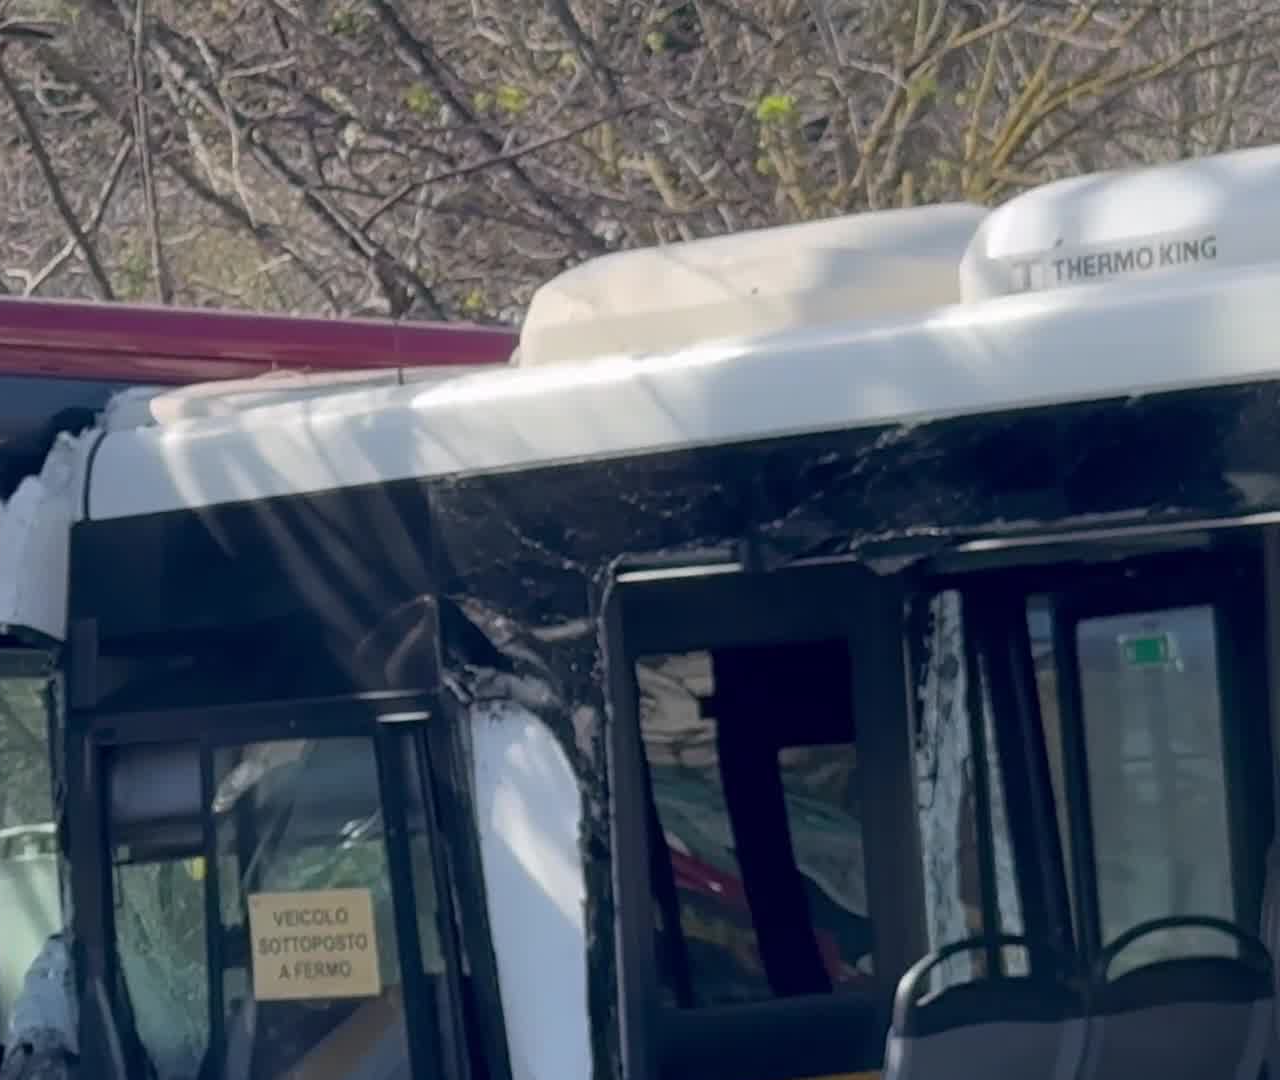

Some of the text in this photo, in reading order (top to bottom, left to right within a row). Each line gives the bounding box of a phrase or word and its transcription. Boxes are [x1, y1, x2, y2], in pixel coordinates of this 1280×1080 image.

[1053, 236, 1218, 281] THERMO KING
[273, 907, 348, 927] VEICOLO
[258, 933, 368, 955] SOTTOPOSTO
[279, 960, 352, 979] A FERMO
